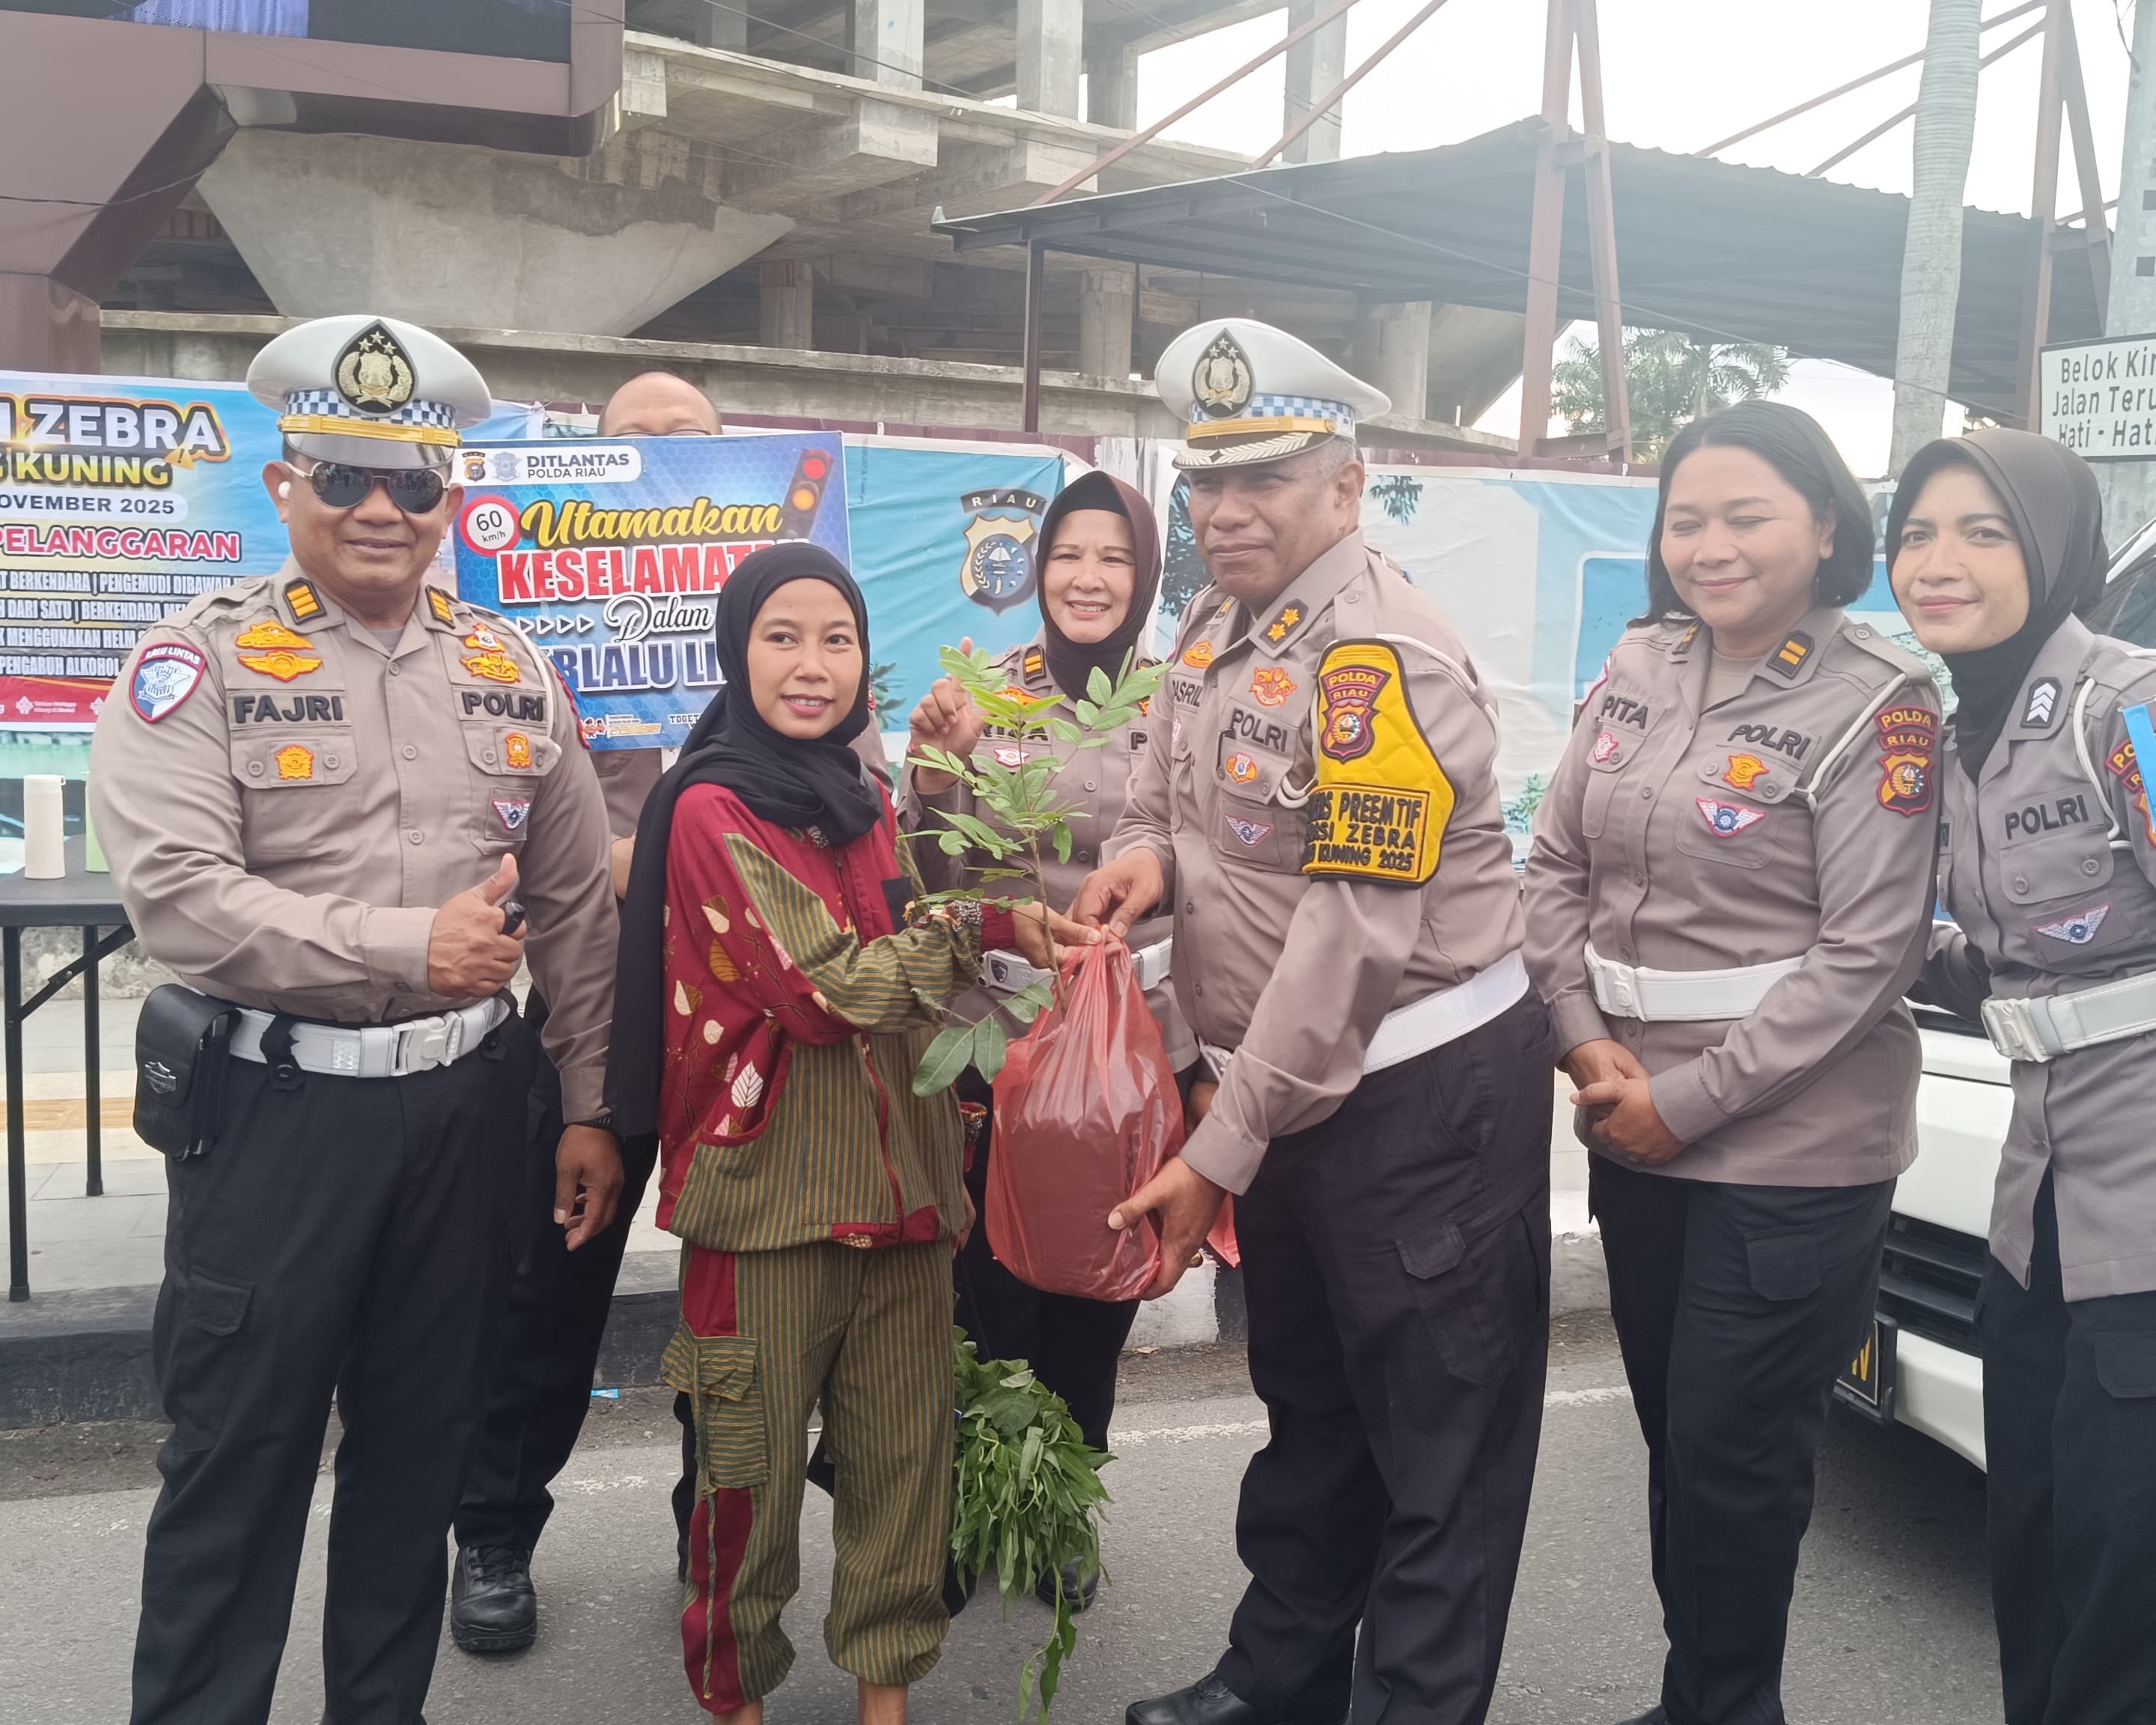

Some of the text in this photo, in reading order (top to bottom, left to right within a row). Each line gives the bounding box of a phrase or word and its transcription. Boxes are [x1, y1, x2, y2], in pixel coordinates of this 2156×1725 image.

[2061, 346, 2156, 383] Belok Kir
[2052, 386, 2156, 416] Jalan Teru
[30, 403, 222, 451] ZEBRA
[2059, 419, 2091, 448] Hati
[2112, 418, 2156, 447] Hat
[16, 451, 168, 485] KUNING
[527, 454, 630, 468] DITLANTAS
[528, 468, 606, 478] POLDA RIAU
[0, 493, 174, 514] OVEMBER 2025
[972, 494, 1037, 508] RIAU
[476, 511, 502, 532] 60
[521, 498, 783, 547] Utamakan
[0, 528, 239, 559] ELANGGARAN
[482, 530, 506, 543] km/h
[9, 571, 91, 592] BERKENDARA
[100, 574, 171, 594] PENGEMUDI
[500, 544, 774, 599] KESELAMAT
[7, 600, 38, 618] DARI
[40, 600, 72, 619] SATU
[81, 602, 162, 621] BERKENDARA
[605, 595, 712, 642] Dalam
[6, 628, 100, 648] MENGGUNAKAN
[103, 630, 135, 648] HELM
[67, 657, 120, 676] ALKOHOL
[168, 646, 201, 665] LINTAS
[551, 642, 674, 688] RLALU
[1328, 672, 1377, 687] POLDA
[463, 691, 546, 721] POLRI
[1333, 689, 1368, 699] RIAU
[234, 695, 343, 724] FAJRI
[1881, 710, 1931, 728] POLDA
[1231, 708, 1288, 752] POLRI
[1727, 724, 1811, 761] POLRI
[1886, 734, 1929, 746] RIAU
[1339, 791, 1422, 829] PREEMTIF
[2004, 794, 2089, 840] POLRI
[1346, 824, 1416, 851] ZEBRA
[1318, 843, 1371, 865] KUNING
[1377, 849, 1415, 871] 2025
